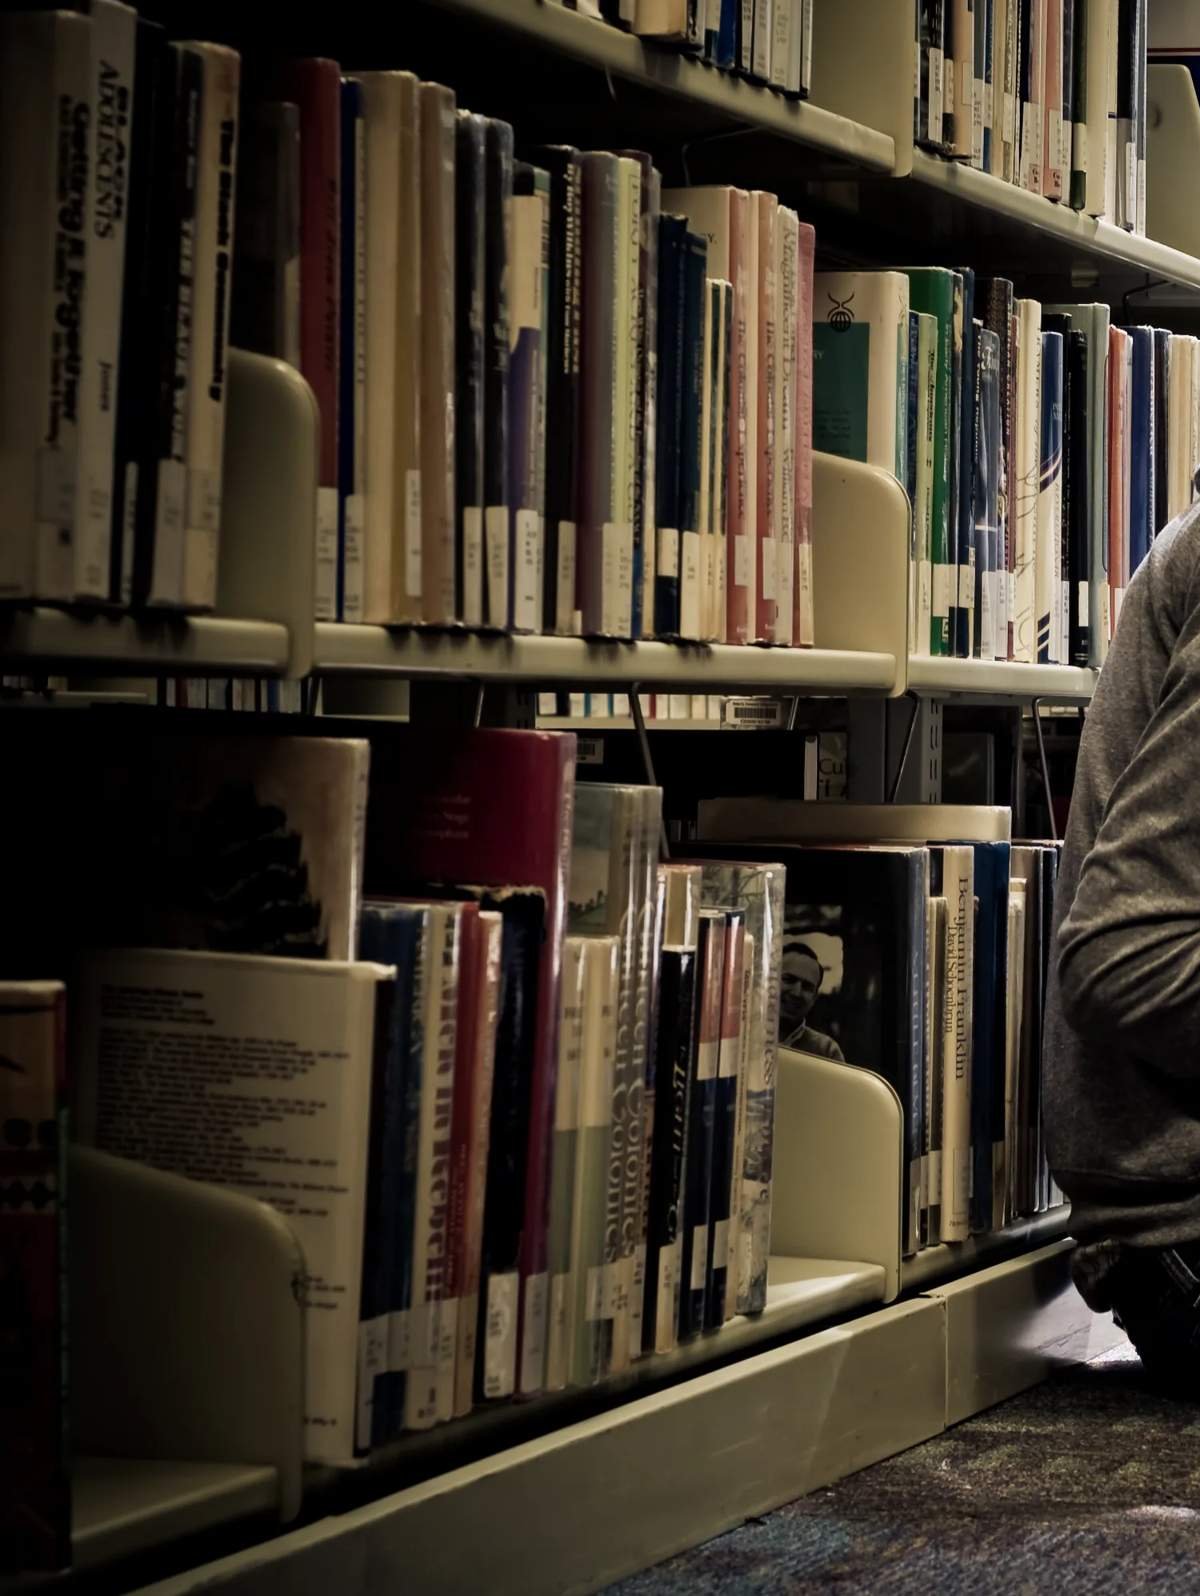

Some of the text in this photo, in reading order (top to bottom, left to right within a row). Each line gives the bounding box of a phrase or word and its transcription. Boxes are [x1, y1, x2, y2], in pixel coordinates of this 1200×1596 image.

[60, 102, 90, 233] Getting
[95, 59, 120, 240] ADOLESCENTS
[562, 163, 575, 183] By
[562, 185, 575, 213] Roy
[209, 119, 234, 402] The Black Community
[565, 215, 576, 278] Wilkins
[780, 227, 792, 350] Magnificent
[54, 268, 84, 424] Together
[945, 925, 958, 960] David
[953, 877, 970, 1081] Benjamin Franklin
[436, 979, 458, 1075] Men
[433, 1086, 455, 1130] in
[621, 1077, 645, 1258] Colonies
[603, 1082, 627, 1264] Colonies
